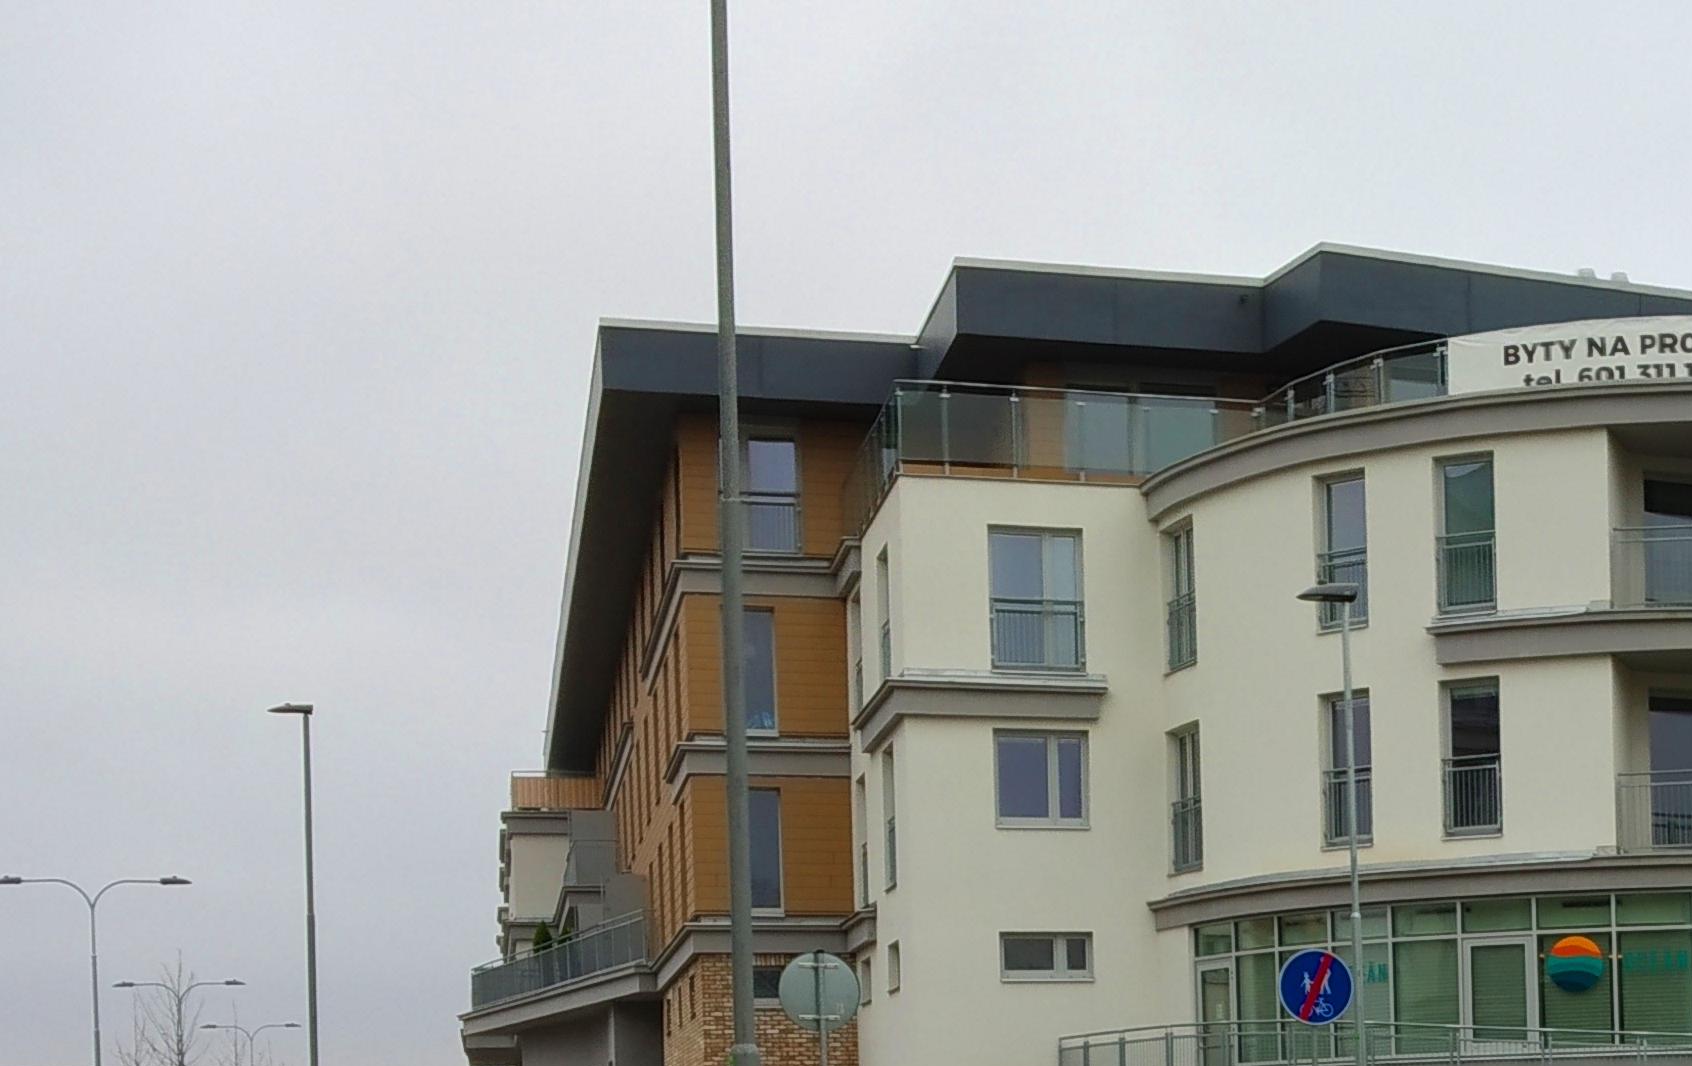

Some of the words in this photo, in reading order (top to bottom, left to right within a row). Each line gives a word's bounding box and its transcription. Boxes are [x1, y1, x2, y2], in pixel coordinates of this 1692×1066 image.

[1503, 339, 1577, 366] BYTY
[1587, 335, 1631, 358] NA
[1578, 365, 1627, 382] 601
[1637, 363, 1677, 379] 311
